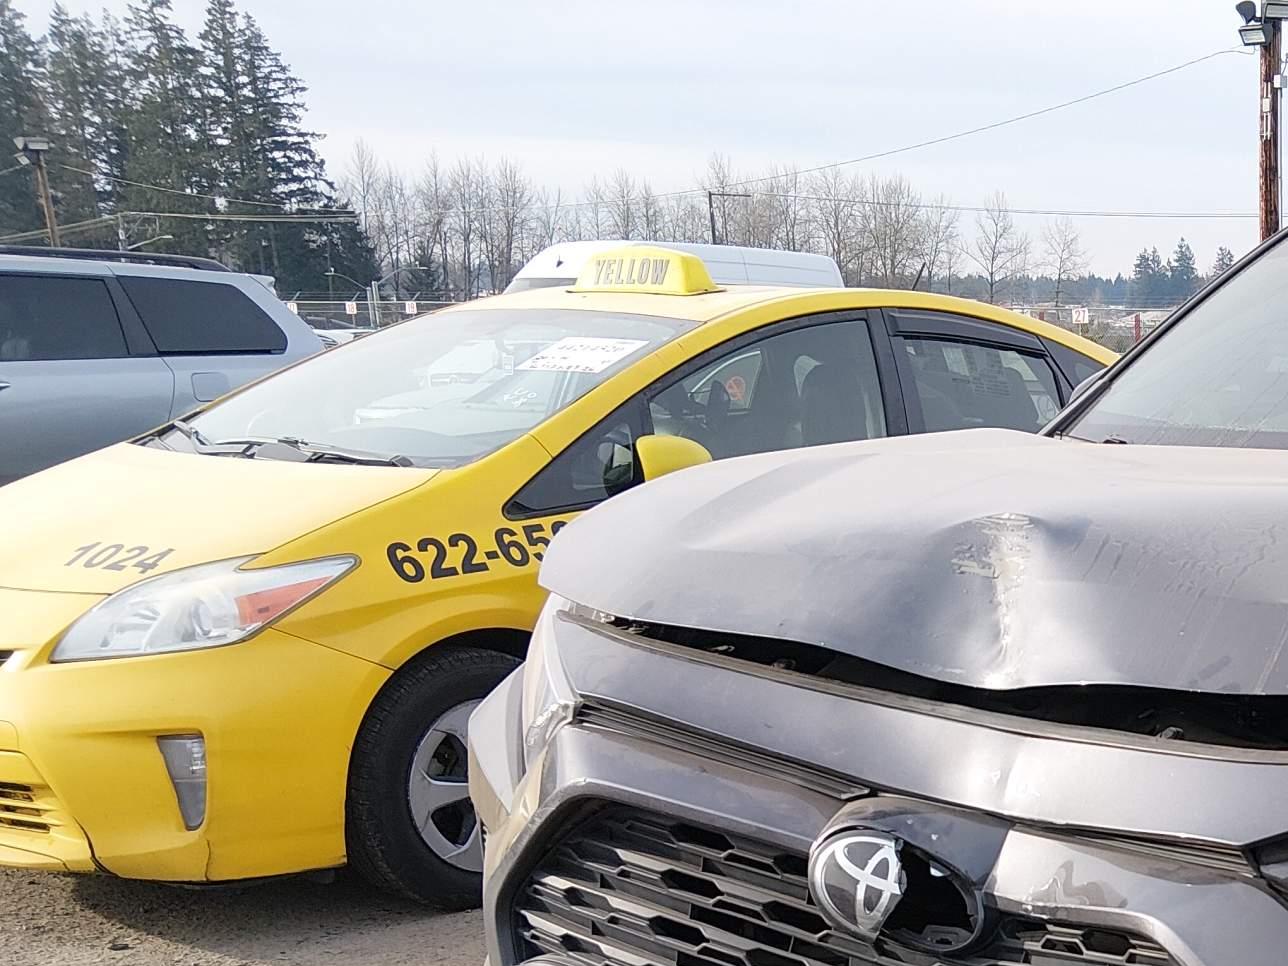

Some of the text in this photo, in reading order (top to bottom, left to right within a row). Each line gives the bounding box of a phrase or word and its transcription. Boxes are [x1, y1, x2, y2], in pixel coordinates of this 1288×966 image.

[594, 257, 670, 286] YELLOW
[1075, 309, 1086, 322] 27
[63, 541, 176, 574] 1024
